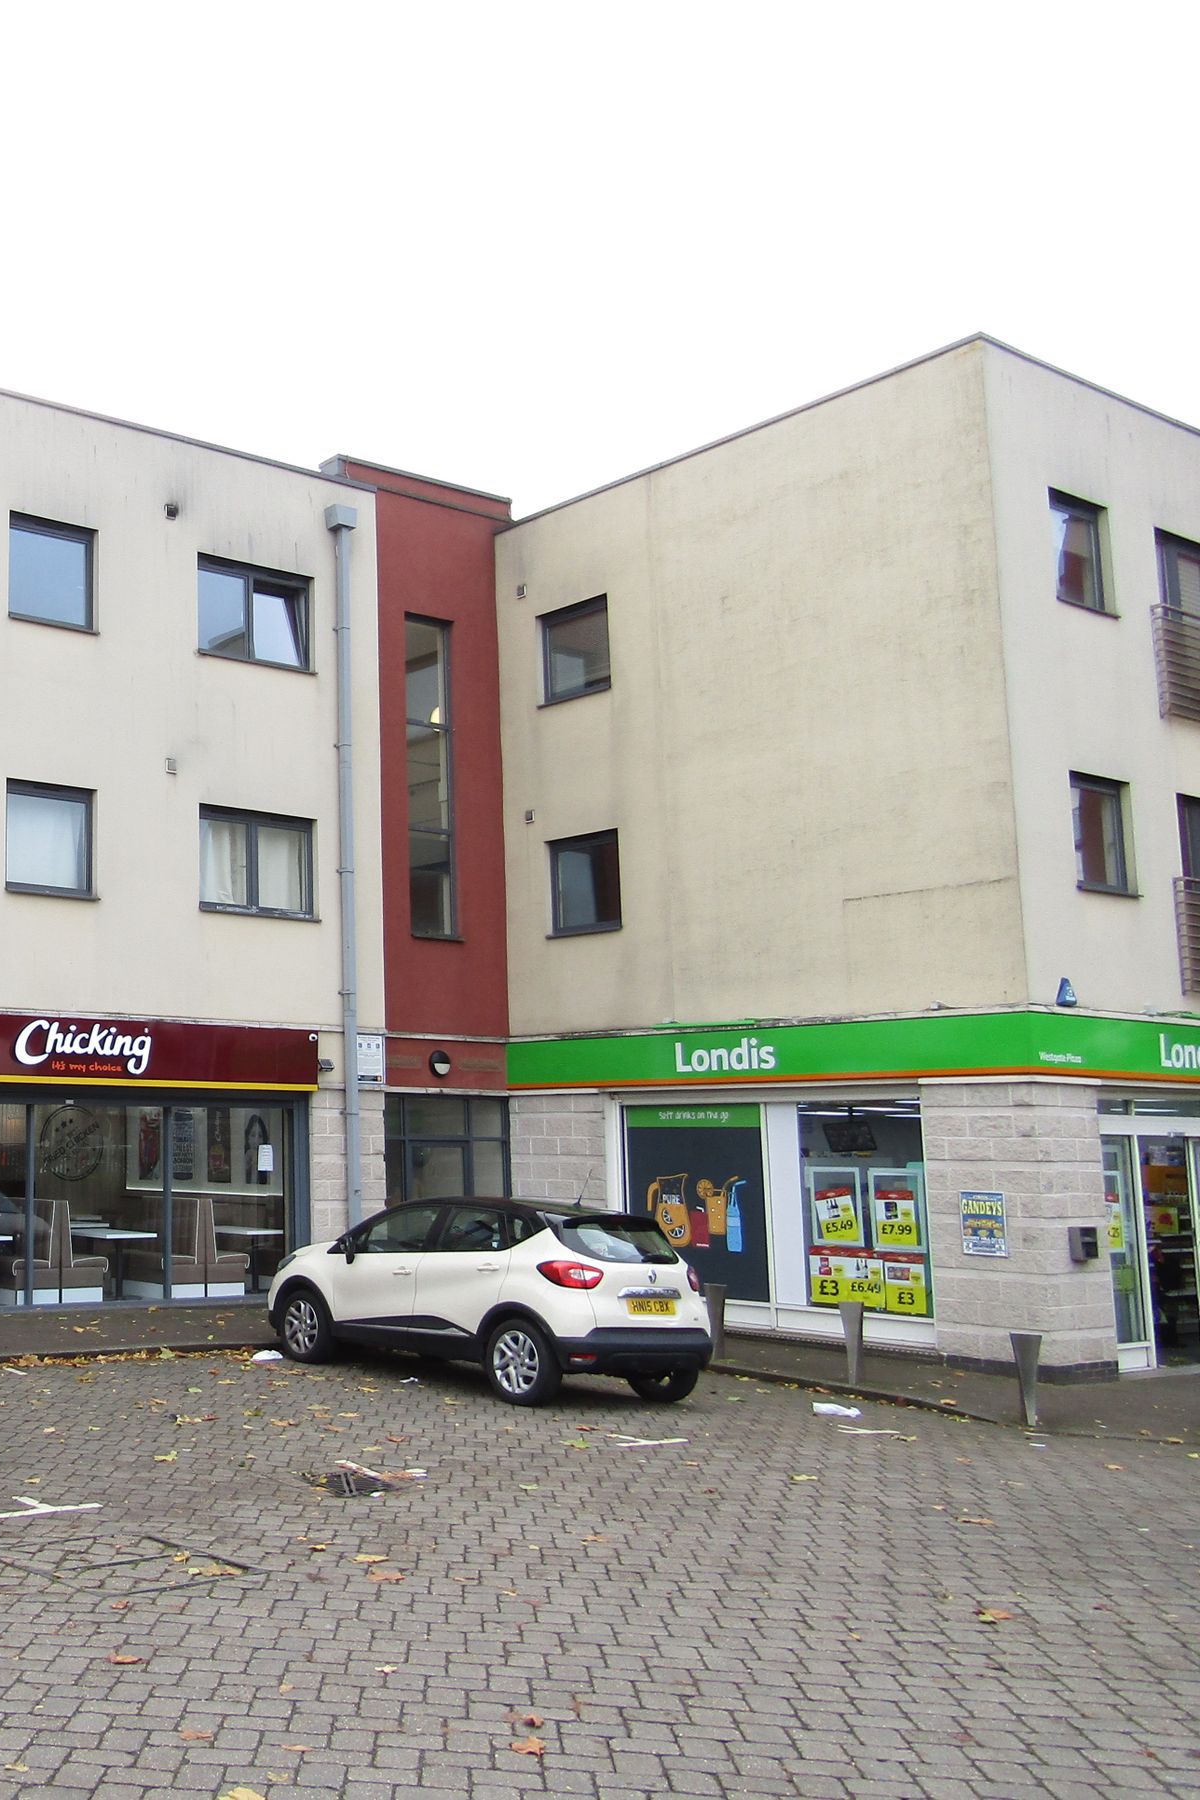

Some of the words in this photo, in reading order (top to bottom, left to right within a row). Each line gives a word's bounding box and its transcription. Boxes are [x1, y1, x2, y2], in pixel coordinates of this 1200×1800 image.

[14, 1019, 152, 1075] Chicking
[675, 1037, 776, 1073] Londis
[51, 1060, 66, 1071] it's
[69, 1063, 86, 1073] my
[89, 1061, 122, 1072] choice
[662, 1193, 681, 1205] PURE
[825, 1219, 854, 1234] £5.49
[881, 1224, 912, 1236] £7.99
[819, 1279, 840, 1297] £3
[851, 1281, 881, 1294] £6.49
[897, 1291, 915, 1306] £3
